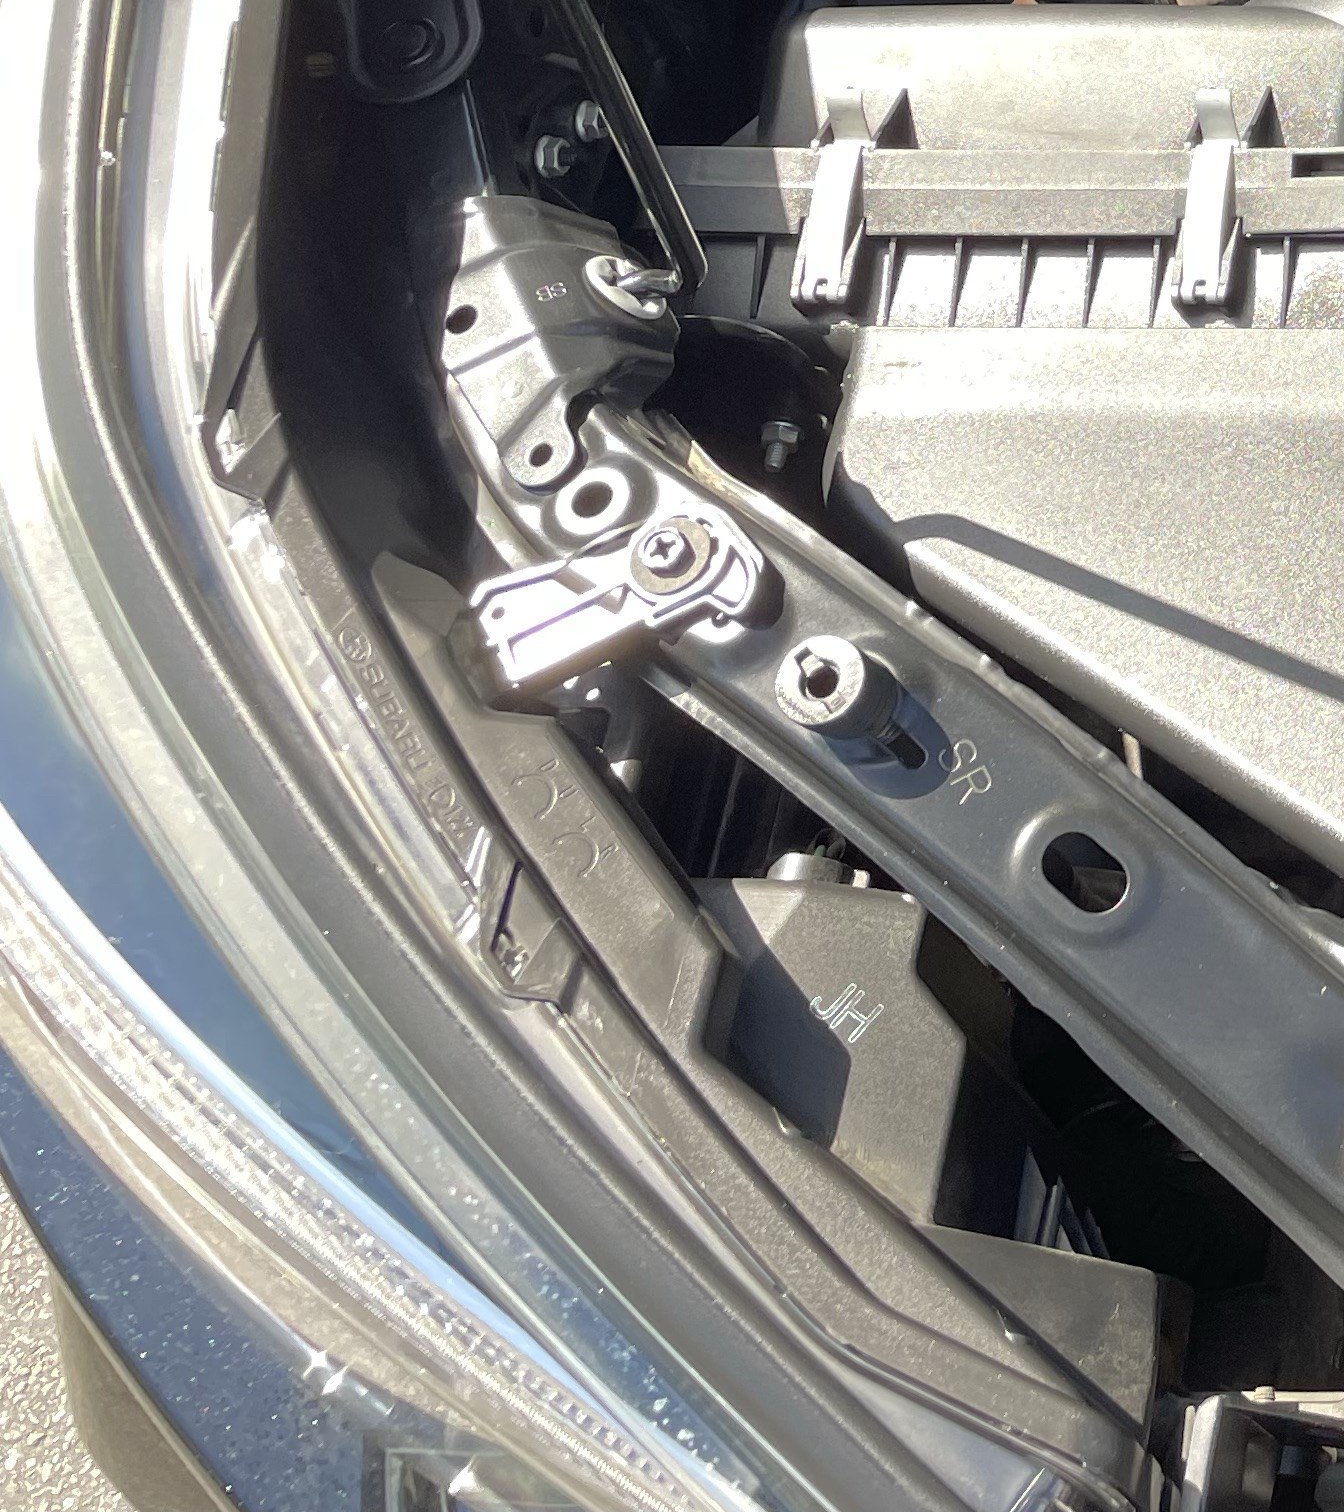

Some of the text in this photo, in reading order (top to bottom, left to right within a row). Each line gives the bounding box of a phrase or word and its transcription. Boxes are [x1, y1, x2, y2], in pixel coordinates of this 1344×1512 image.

[358, 664, 434, 773] SUBARU
[938, 738, 992, 805] SR
[809, 982, 885, 1044] JH
